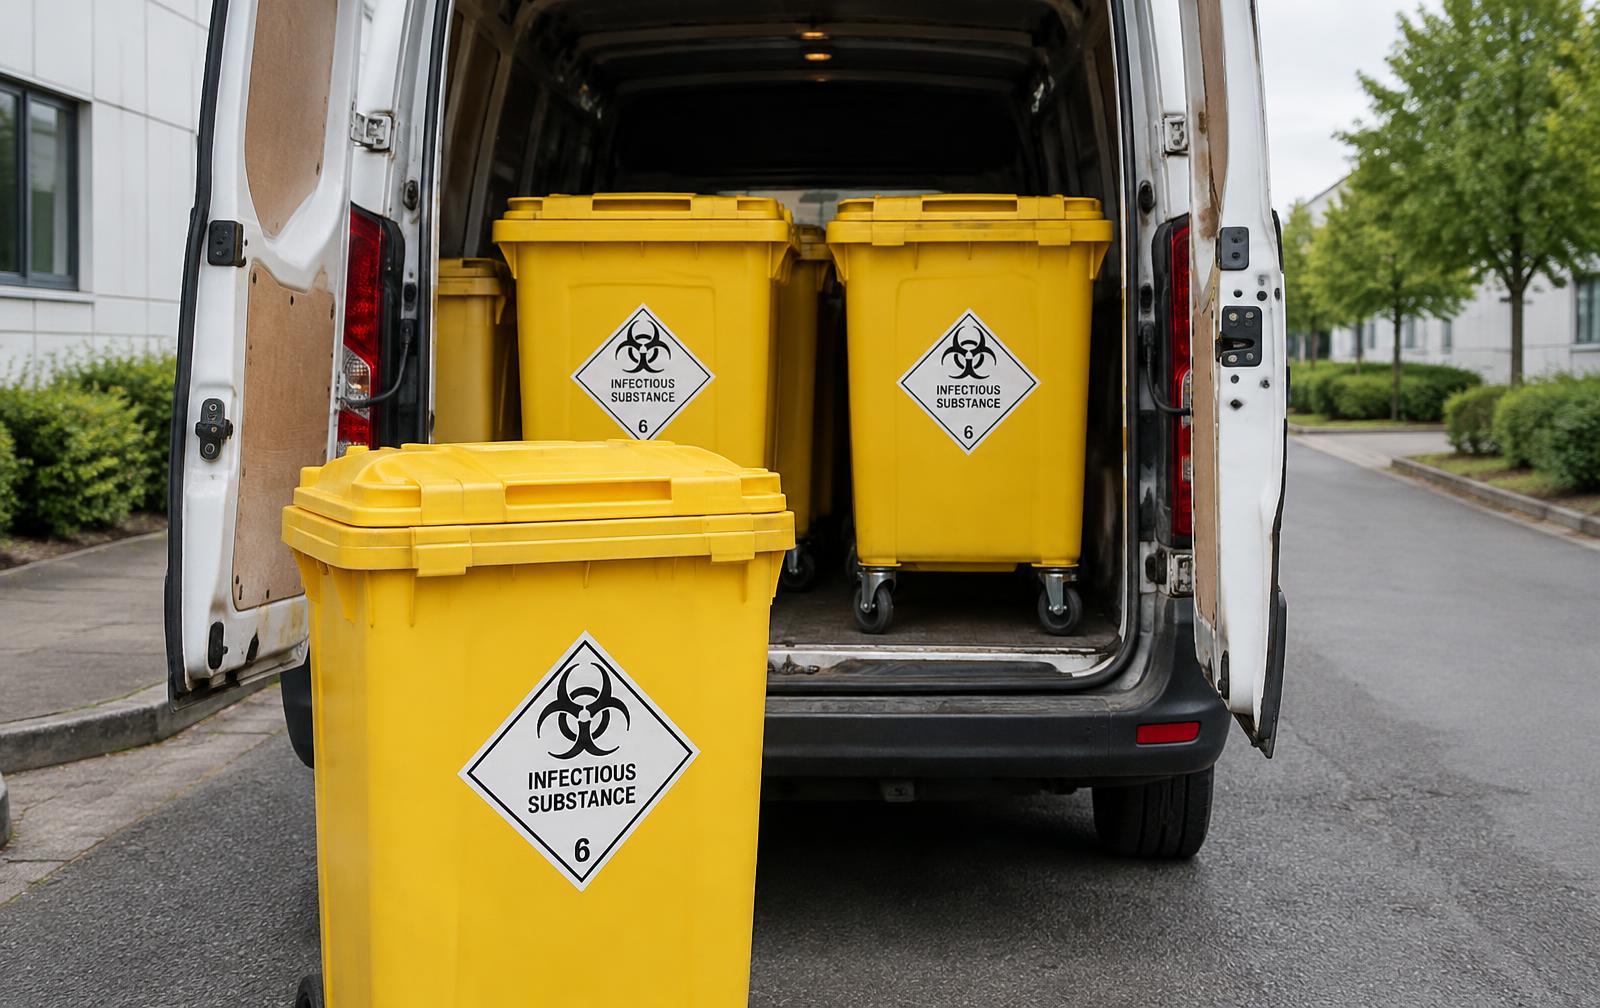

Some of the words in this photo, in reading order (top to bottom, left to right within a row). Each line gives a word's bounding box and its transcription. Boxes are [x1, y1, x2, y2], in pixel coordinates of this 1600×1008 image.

[611, 379, 675, 389] INFECTIOUS
[936, 385, 1001, 395] INFECTIOUS
[611, 392, 675, 402] SUBSTANCE
[936, 398, 1001, 408] SUBSTANCE
[638, 420, 648, 433] 6
[964, 425, 973, 439] 6
[528, 763, 636, 790] INFECTIOUS
[528, 786, 636, 814] SUBSTANCE
[574, 837, 590, 863] 6
